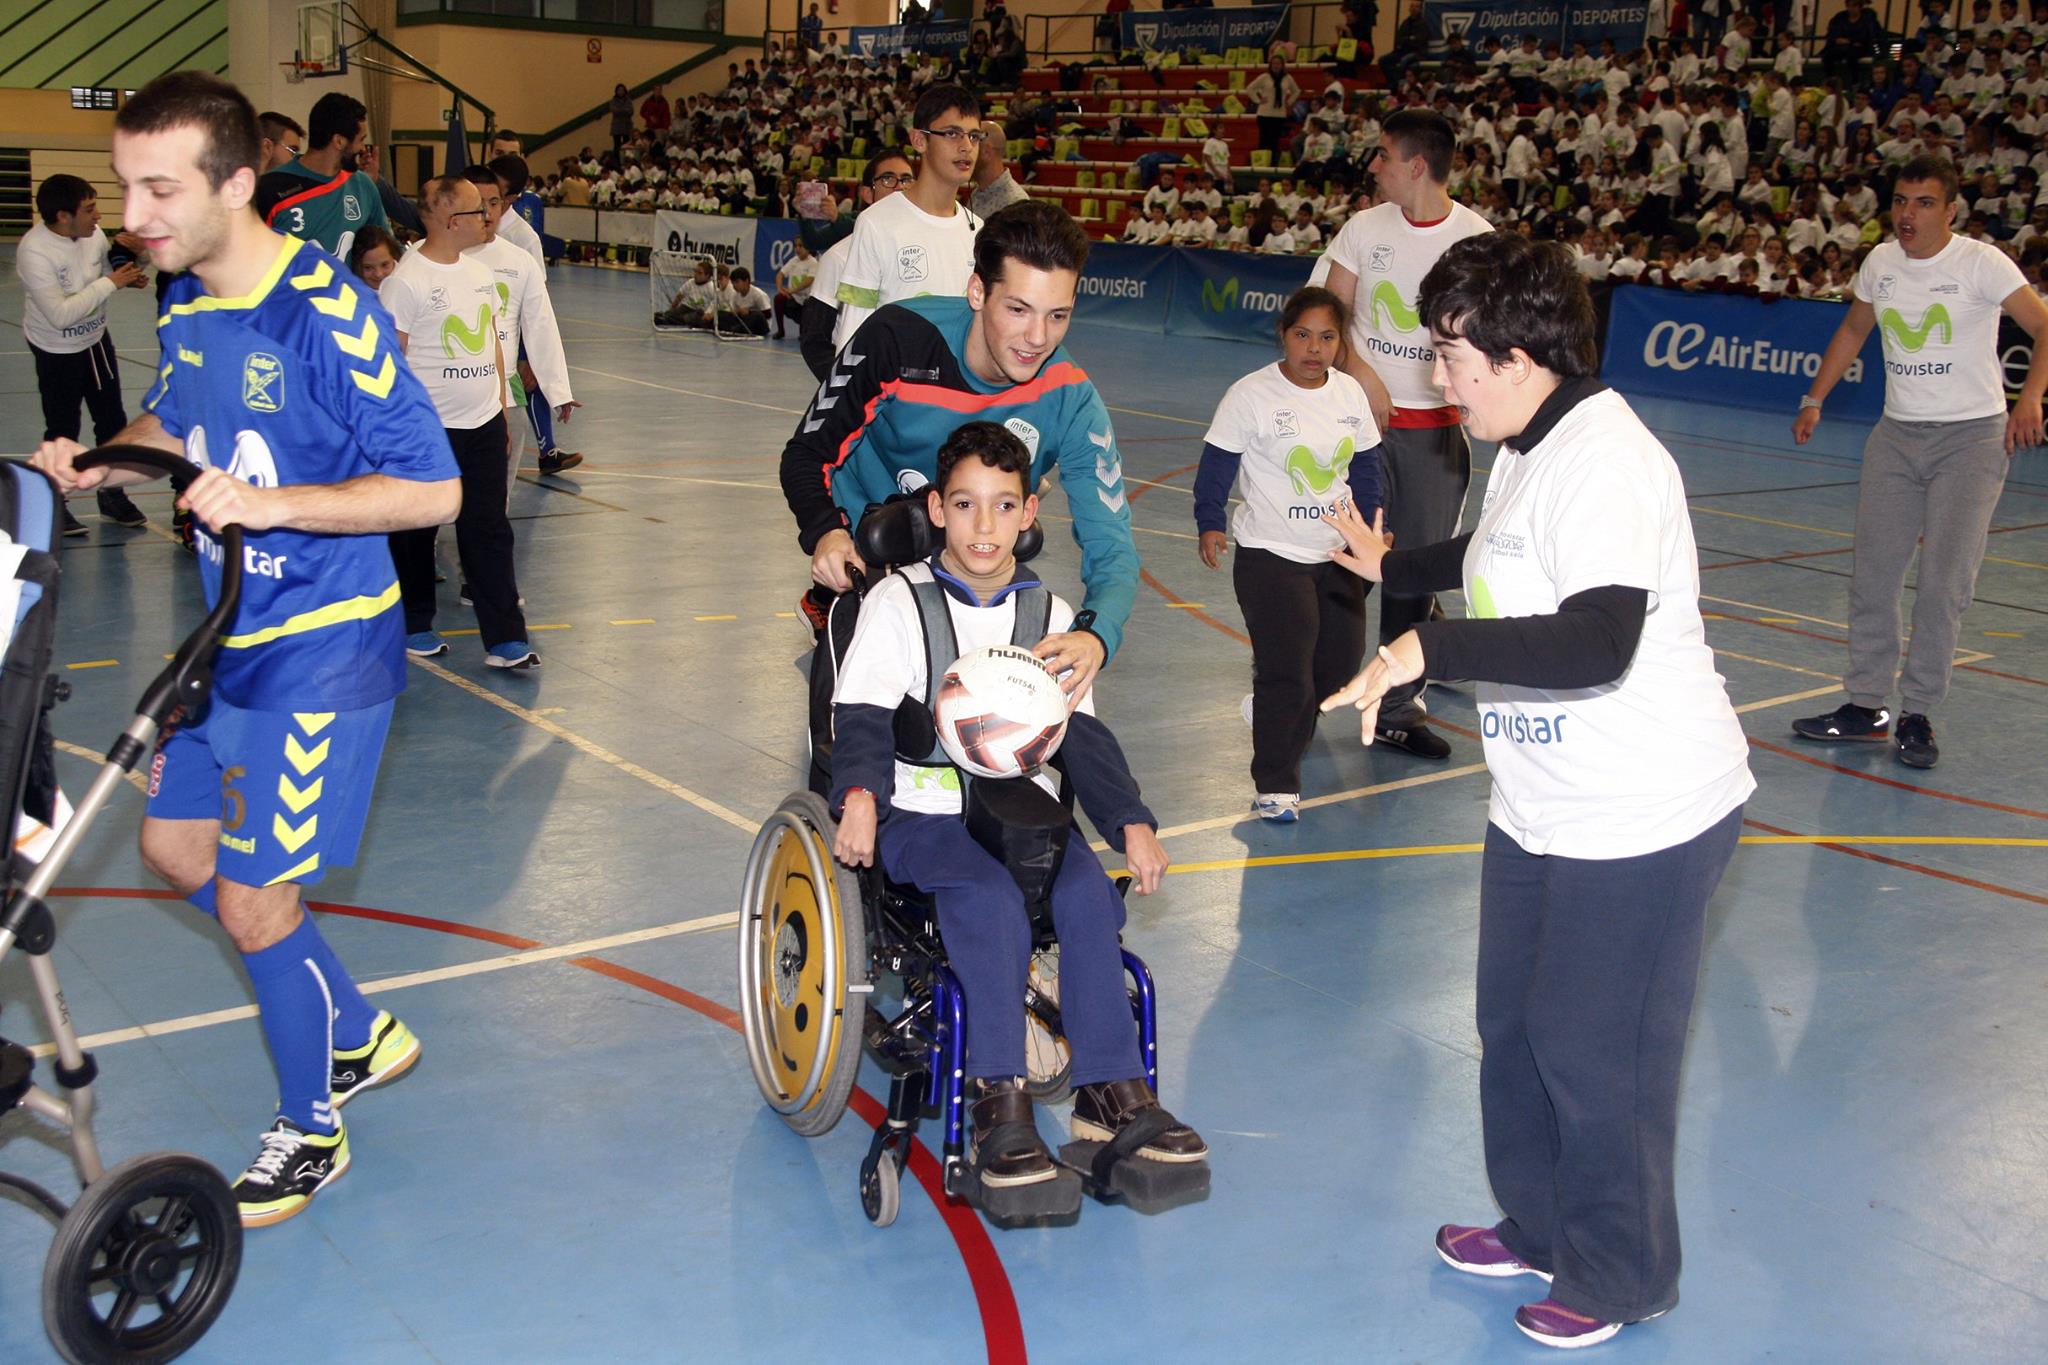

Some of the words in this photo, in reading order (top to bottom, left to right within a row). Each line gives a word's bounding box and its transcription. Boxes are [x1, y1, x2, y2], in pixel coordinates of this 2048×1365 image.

[1162, 19, 1220, 39] Diputación
[1478, 8, 1560, 31] Diputación
[1572, 8, 1646, 26] DEPORTES
[289, 207, 306, 232] 3
[683, 232, 740, 265] hummel
[902, 247, 920, 256] inter
[1705, 335, 1865, 383] AirEuroa
[1885, 360, 1953, 376] movistar
[1010, 419, 1033, 436] inter
[1006, 674, 1038, 693] FUTSAL
